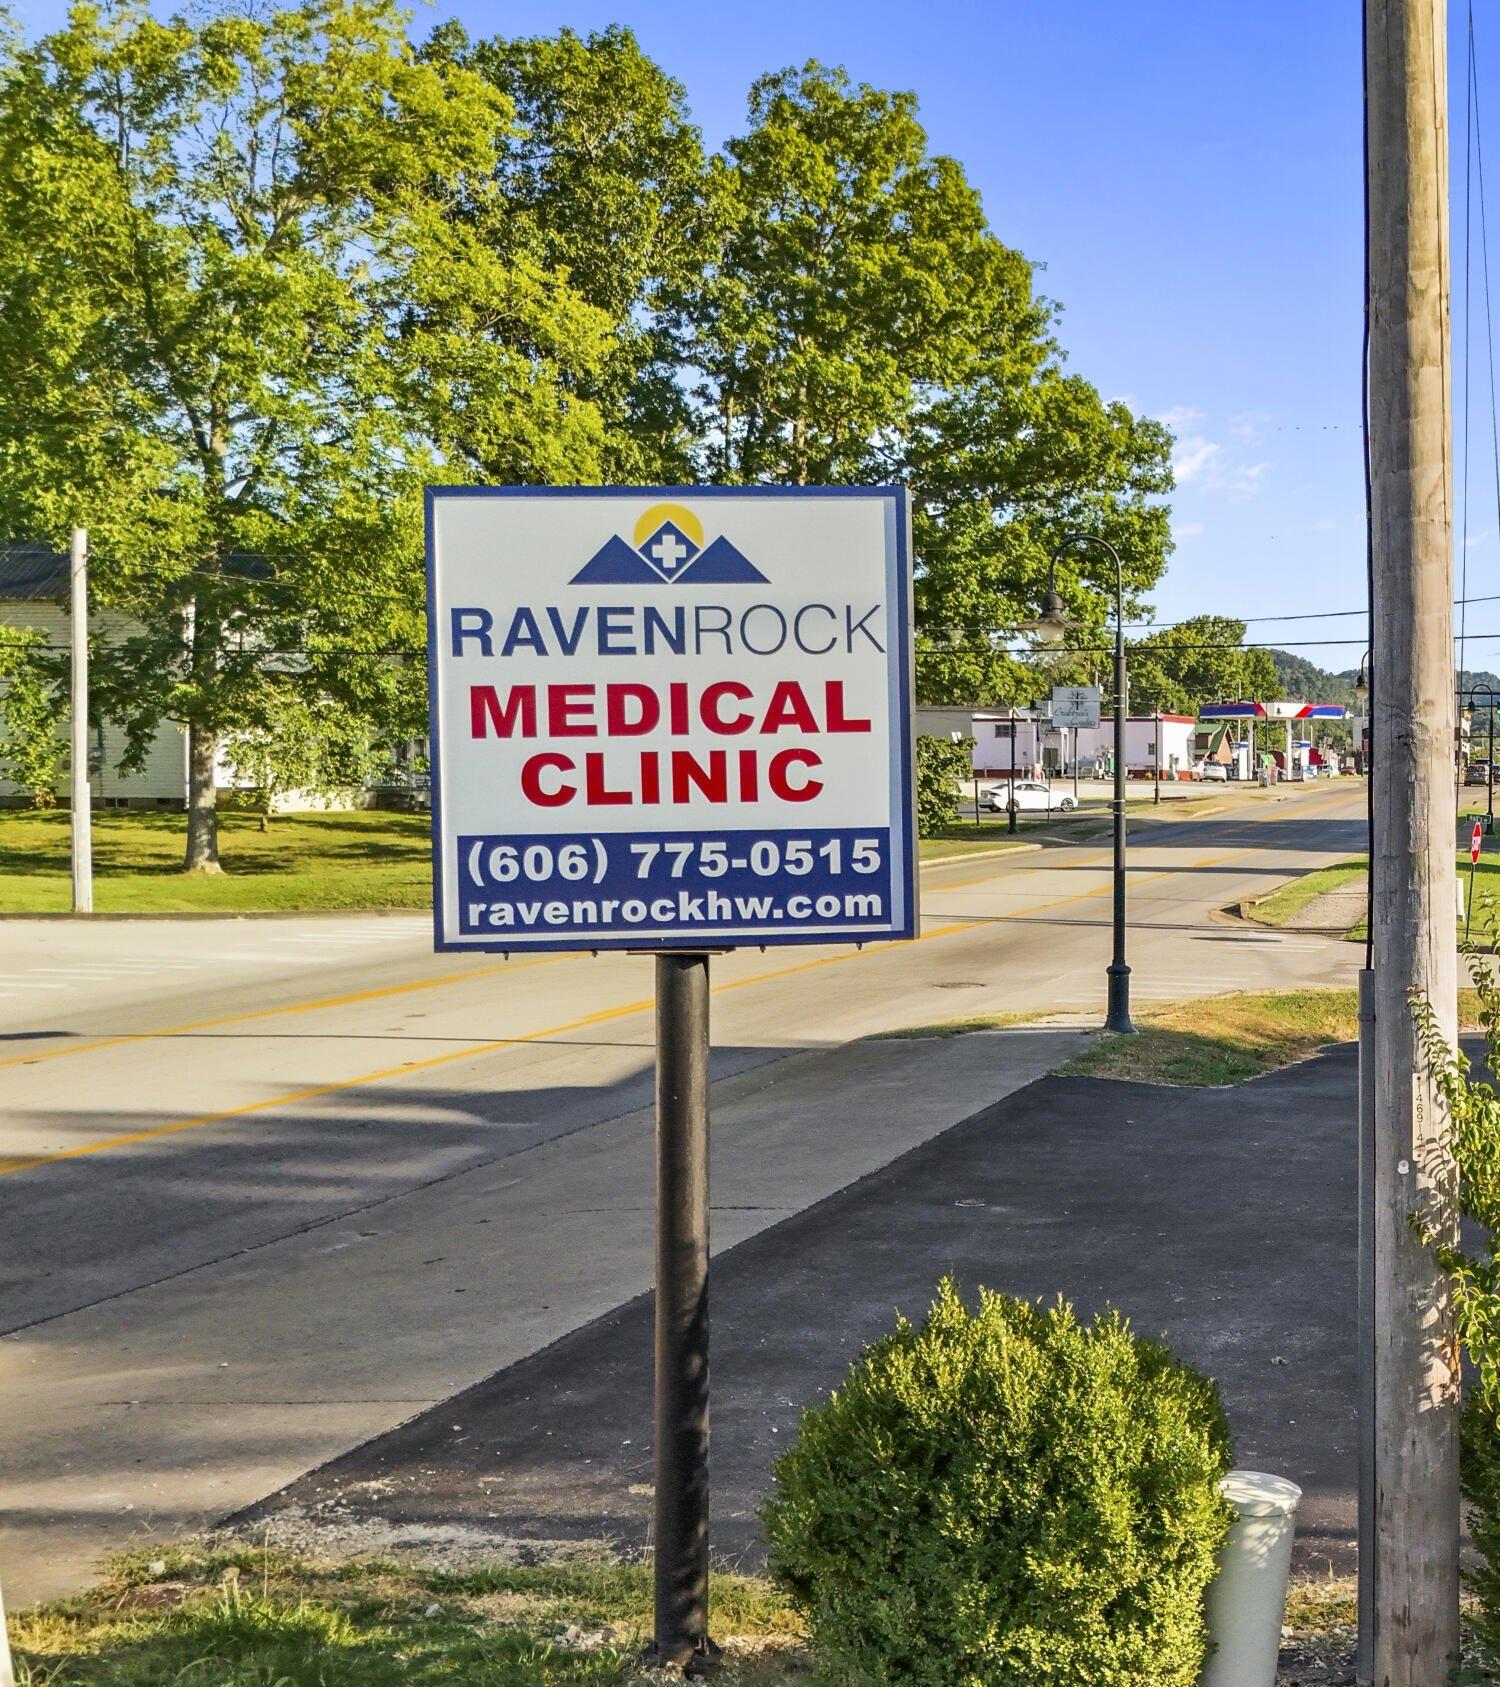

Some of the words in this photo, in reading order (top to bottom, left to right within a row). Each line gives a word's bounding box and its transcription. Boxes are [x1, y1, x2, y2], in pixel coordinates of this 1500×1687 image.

[450, 604, 886, 657] RAVENROCK
[469, 680, 872, 739] MEDICAL
[521, 748, 824, 807] CLINIC
[468, 838, 609, 886] (606)
[630, 838, 881, 880] 775-0515
[469, 891, 882, 926] ravenrockhw.com
